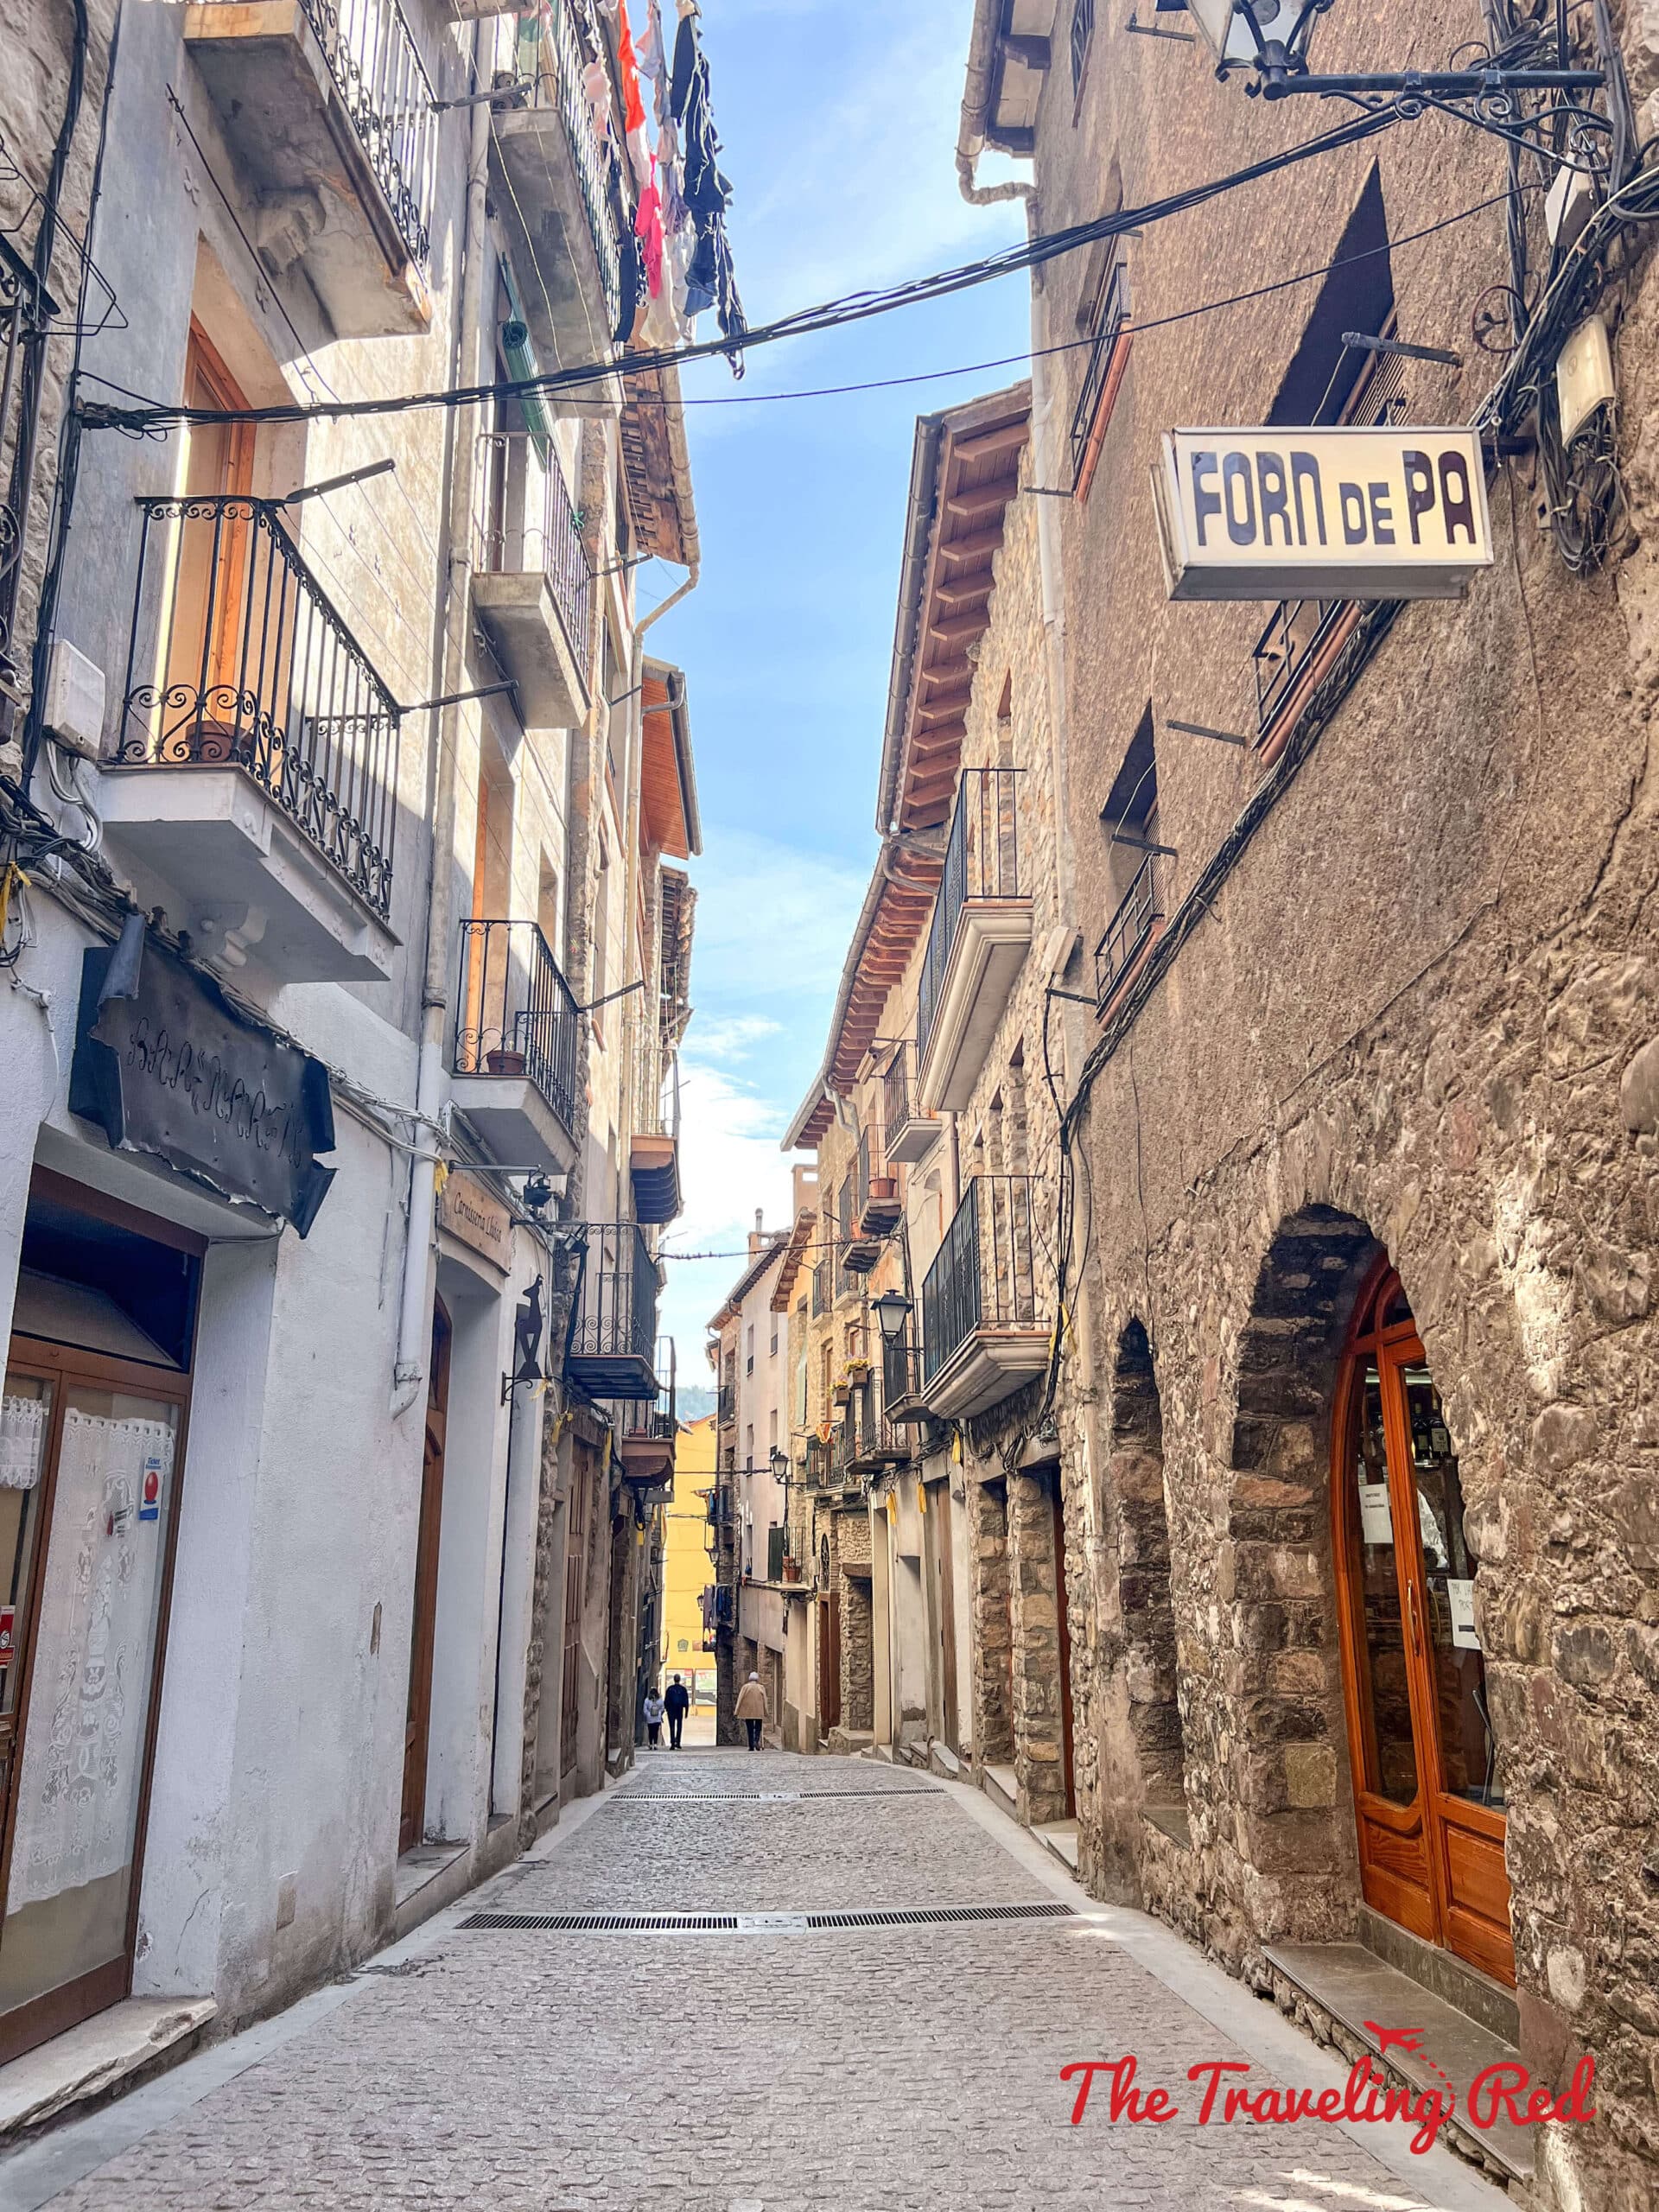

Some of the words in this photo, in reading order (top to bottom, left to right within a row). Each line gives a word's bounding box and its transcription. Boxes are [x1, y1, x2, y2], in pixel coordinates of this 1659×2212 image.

[1190, 450, 1328, 547] FORN
[1338, 481, 1396, 545] DE
[1402, 449, 1478, 544] PA
